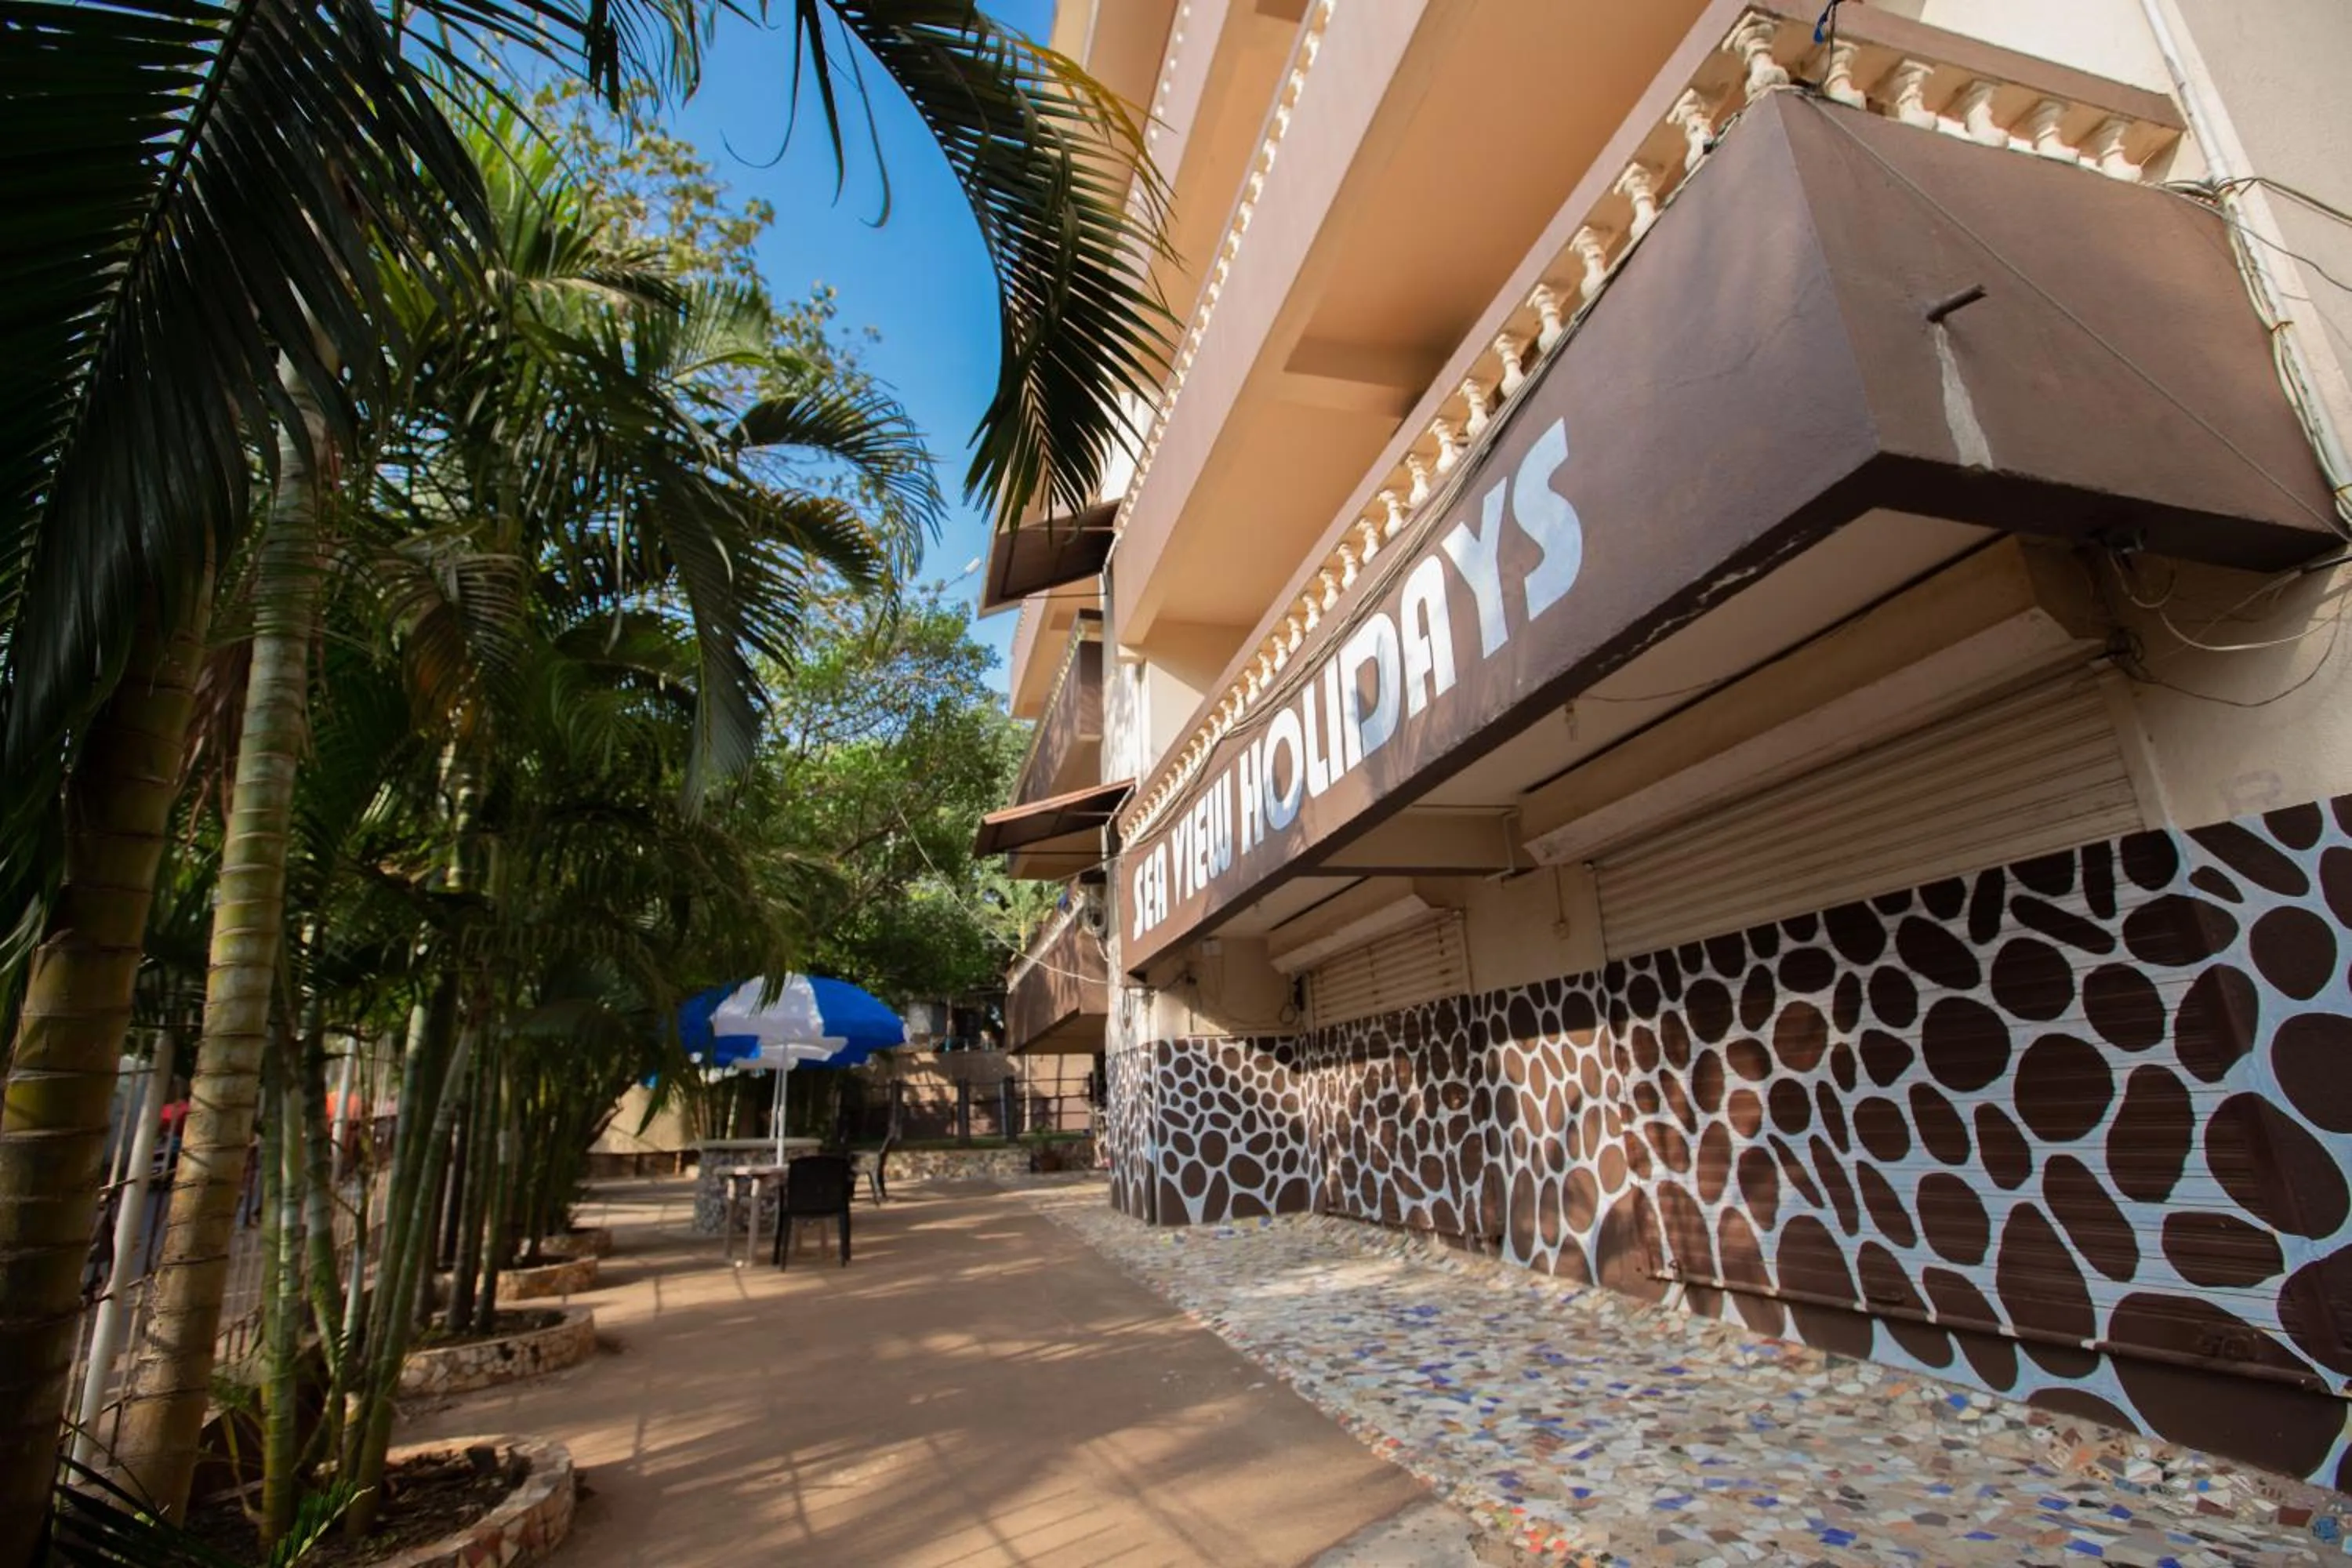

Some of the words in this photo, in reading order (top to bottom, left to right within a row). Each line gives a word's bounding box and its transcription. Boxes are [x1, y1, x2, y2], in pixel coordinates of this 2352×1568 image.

[1134, 841, 1167, 942] SEA
[1171, 768, 1232, 906] VIEW
[1240, 417, 1583, 855] HOLIDAYS
